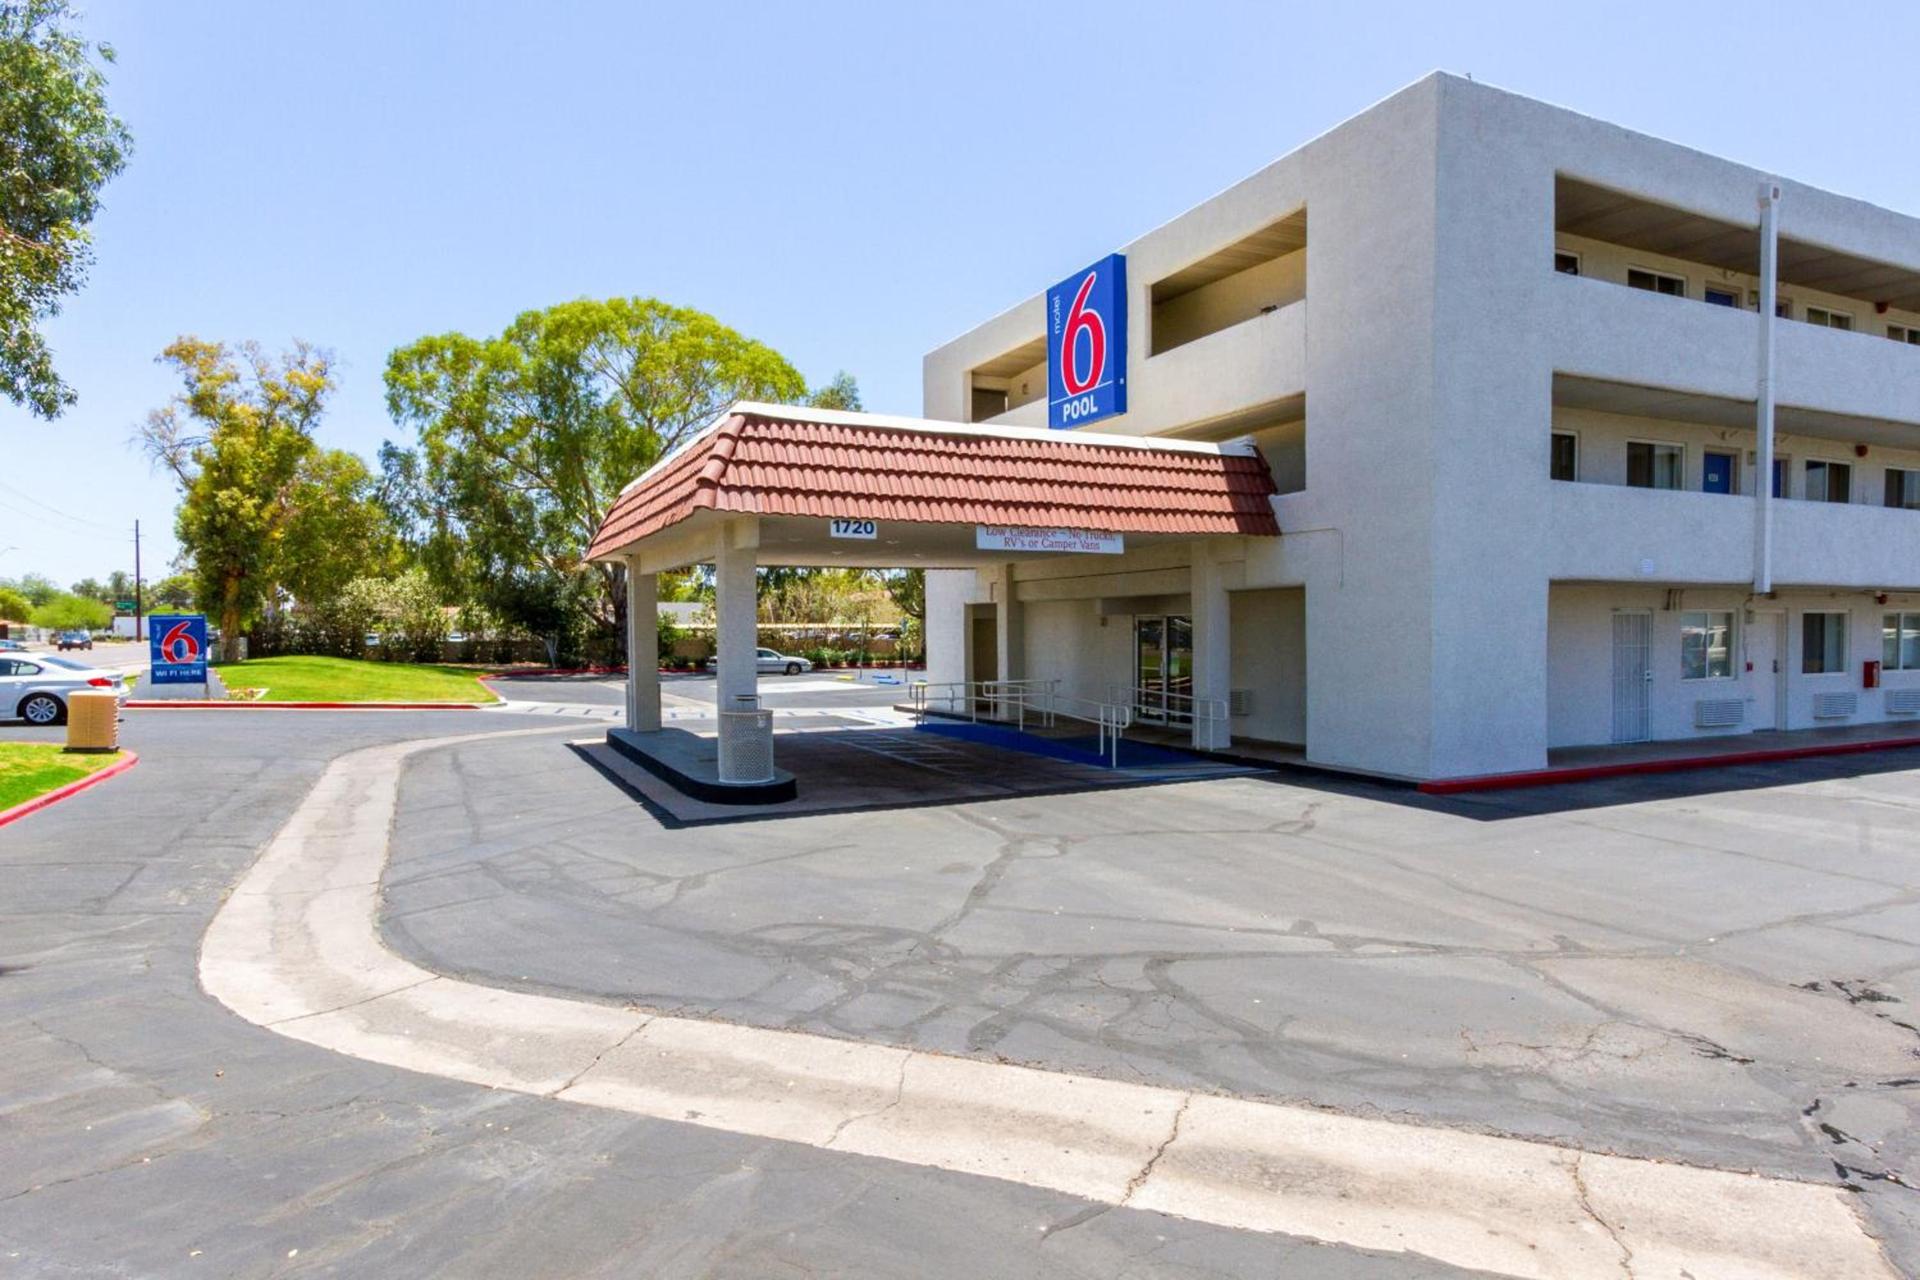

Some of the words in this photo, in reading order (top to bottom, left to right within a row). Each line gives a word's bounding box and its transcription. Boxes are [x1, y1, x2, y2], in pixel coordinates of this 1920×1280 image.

[1060, 271, 1106, 397] 6
[1063, 394, 1098, 422] POOL
[832, 519, 875, 535] 1720
[1028, 540, 1039, 548] or
[1041, 538, 1077, 551] Camper
[1080, 539, 1101, 550] Vans
[161, 620, 199, 665] 6
